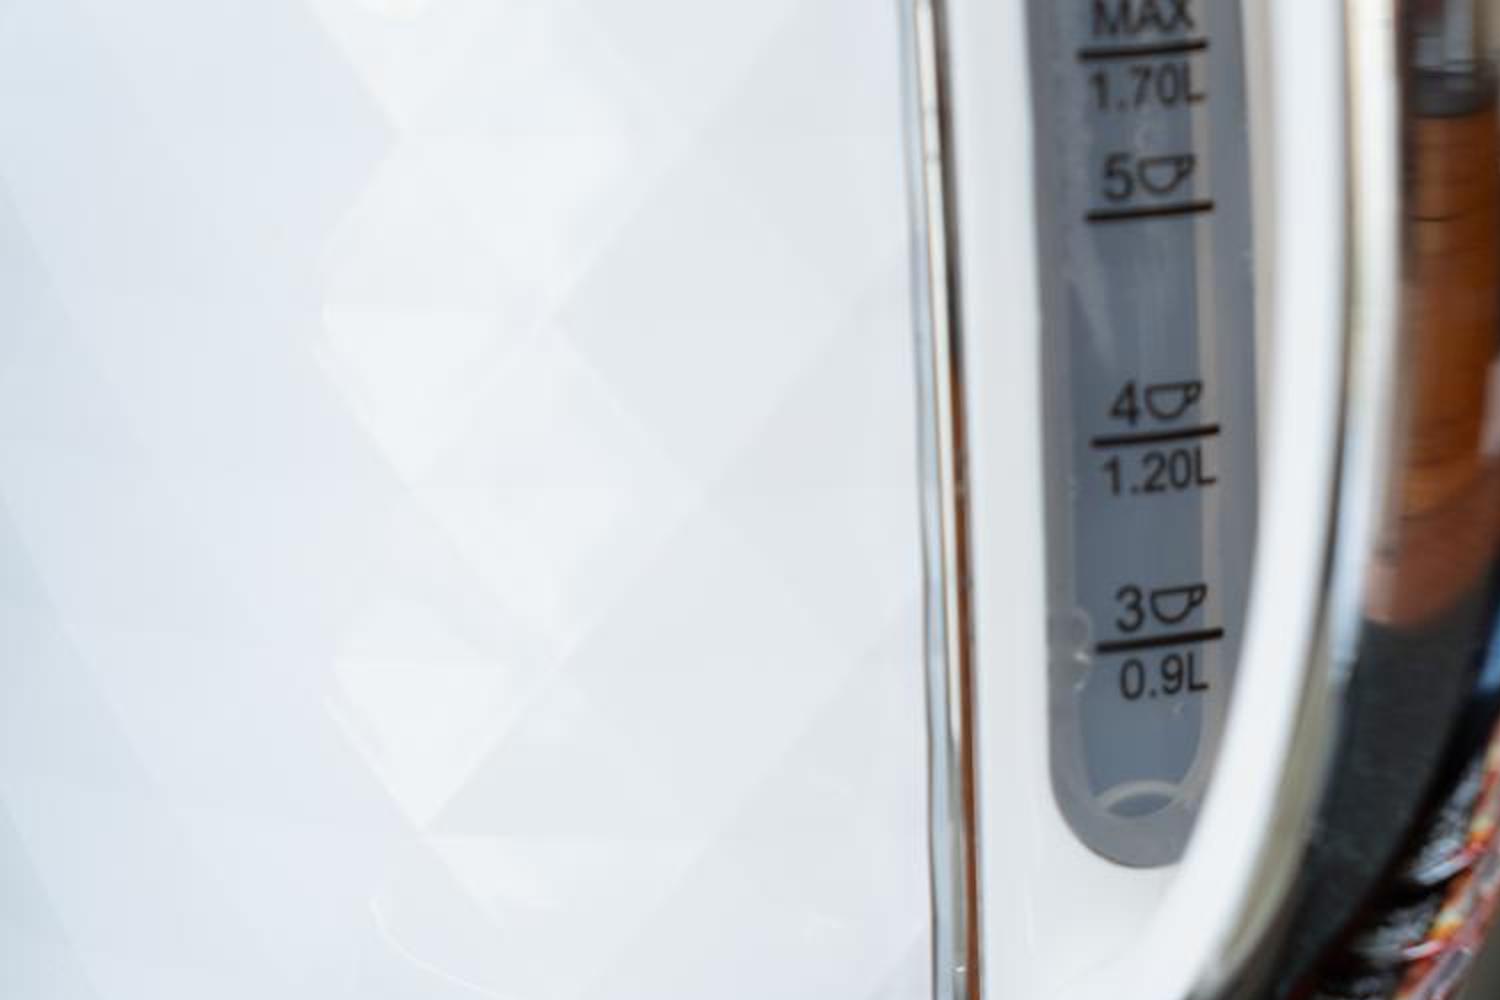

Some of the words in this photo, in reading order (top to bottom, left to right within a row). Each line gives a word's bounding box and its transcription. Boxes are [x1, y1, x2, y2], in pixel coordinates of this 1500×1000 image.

[1091, 0, 1196, 35] MAX
[1088, 60, 1207, 110] 1.70L
[1102, 153, 1134, 203] 5
[1109, 380, 1140, 426] 4
[1102, 446, 1217, 496] 1.20L
[1115, 584, 1146, 634] 3
[1119, 652, 1209, 702] 0.9L
